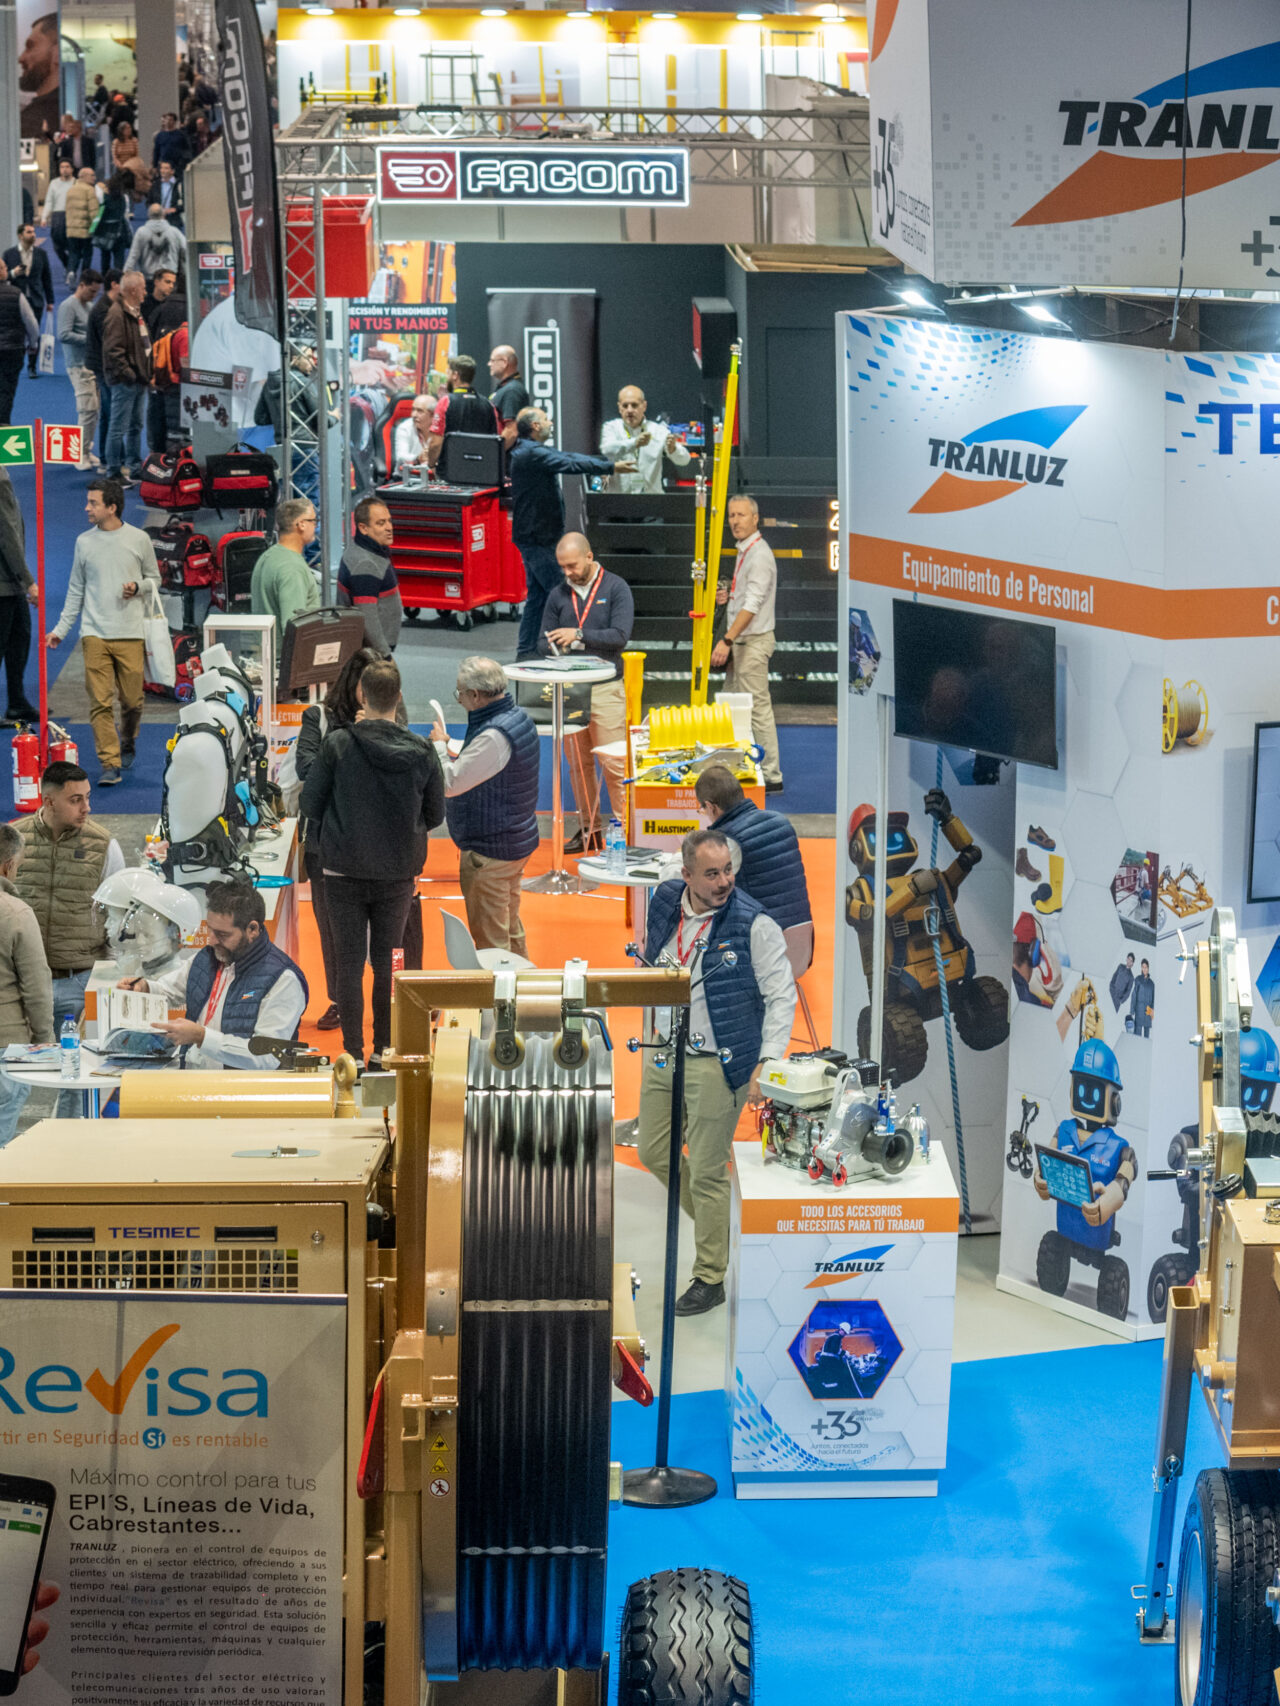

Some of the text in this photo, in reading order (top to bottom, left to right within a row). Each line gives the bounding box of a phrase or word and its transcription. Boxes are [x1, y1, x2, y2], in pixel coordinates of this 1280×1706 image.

[1058, 100, 1280, 149] TRANL
[467, 159, 678, 194] FACOM
[384, 307, 391, 315] Y
[391, 307, 448, 315] RENDIMIENTO
[364, 318, 392, 330] TUS
[395, 318, 448, 330] MANOS
[928, 438, 1068, 487] TRANLUZ
[902, 551, 1095, 614] Equipamiento de Personal
[644, 821, 656, 833] H
[801, 1205, 902, 1217] TODO LOS ACCESORIOS
[777, 1217, 925, 1232] QUE NECESITAS PARA TÚ TRABAJO
[108, 1227, 201, 1239] TESMEC
[814, 1262, 885, 1272] TRANLUZ
[26, 1431, 47, 1444] en
[53, 1429, 140, 1449] Seguridad
[145, 1430, 164, 1448] Sí
[172, 1435, 191, 1446] es
[196, 1431, 269, 1447] rentable
[70, 1468, 317, 1492] Máximo control para tus
[144, 1496, 217, 1513] Líneas
[225, 1496, 253, 1513] de
[259, 1497, 315, 1519] Vida,
[69, 1514, 242, 1534] Cabrestantes...
[70, 1543, 117, 1552] TRANLUZ
[131, 1544, 169, 1554] pionera
[193, 1544, 203, 1553] el
[209, 1544, 245, 1554] control
[251, 1545, 263, 1554] de
[269, 1547, 309, 1557] equipos
[314, 1548, 326, 1557] de
[69, 1556, 120, 1566] protección
[144, 1557, 152, 1566] el
[158, 1558, 187, 1567] sector
[193, 1557, 237, 1568] eléctrico,
[243, 1558, 294, 1568] ofreciendo
[312, 1562, 326, 1570] sus
[70, 1568, 107, 1578] clientes
[130, 1571, 167, 1580] sistema
[172, 1570, 184, 1580] de
[190, 1570, 247, 1580] trazabilidad
[253, 1572, 298, 1584] completo
[304, 1574, 309, 1583] y
[70, 1582, 326, 1595] tiempo real para gestionar equipos de protección
[70, 1595, 124, 1603] individual.
[125, 1595, 169, 1606] "Revisa"
[194, 1597, 203, 1605] el
[209, 1597, 259, 1606] resultado
[265, 1598, 277, 1606] de
[284, 1598, 308, 1607] años
[314, 1599, 326, 1607] de
